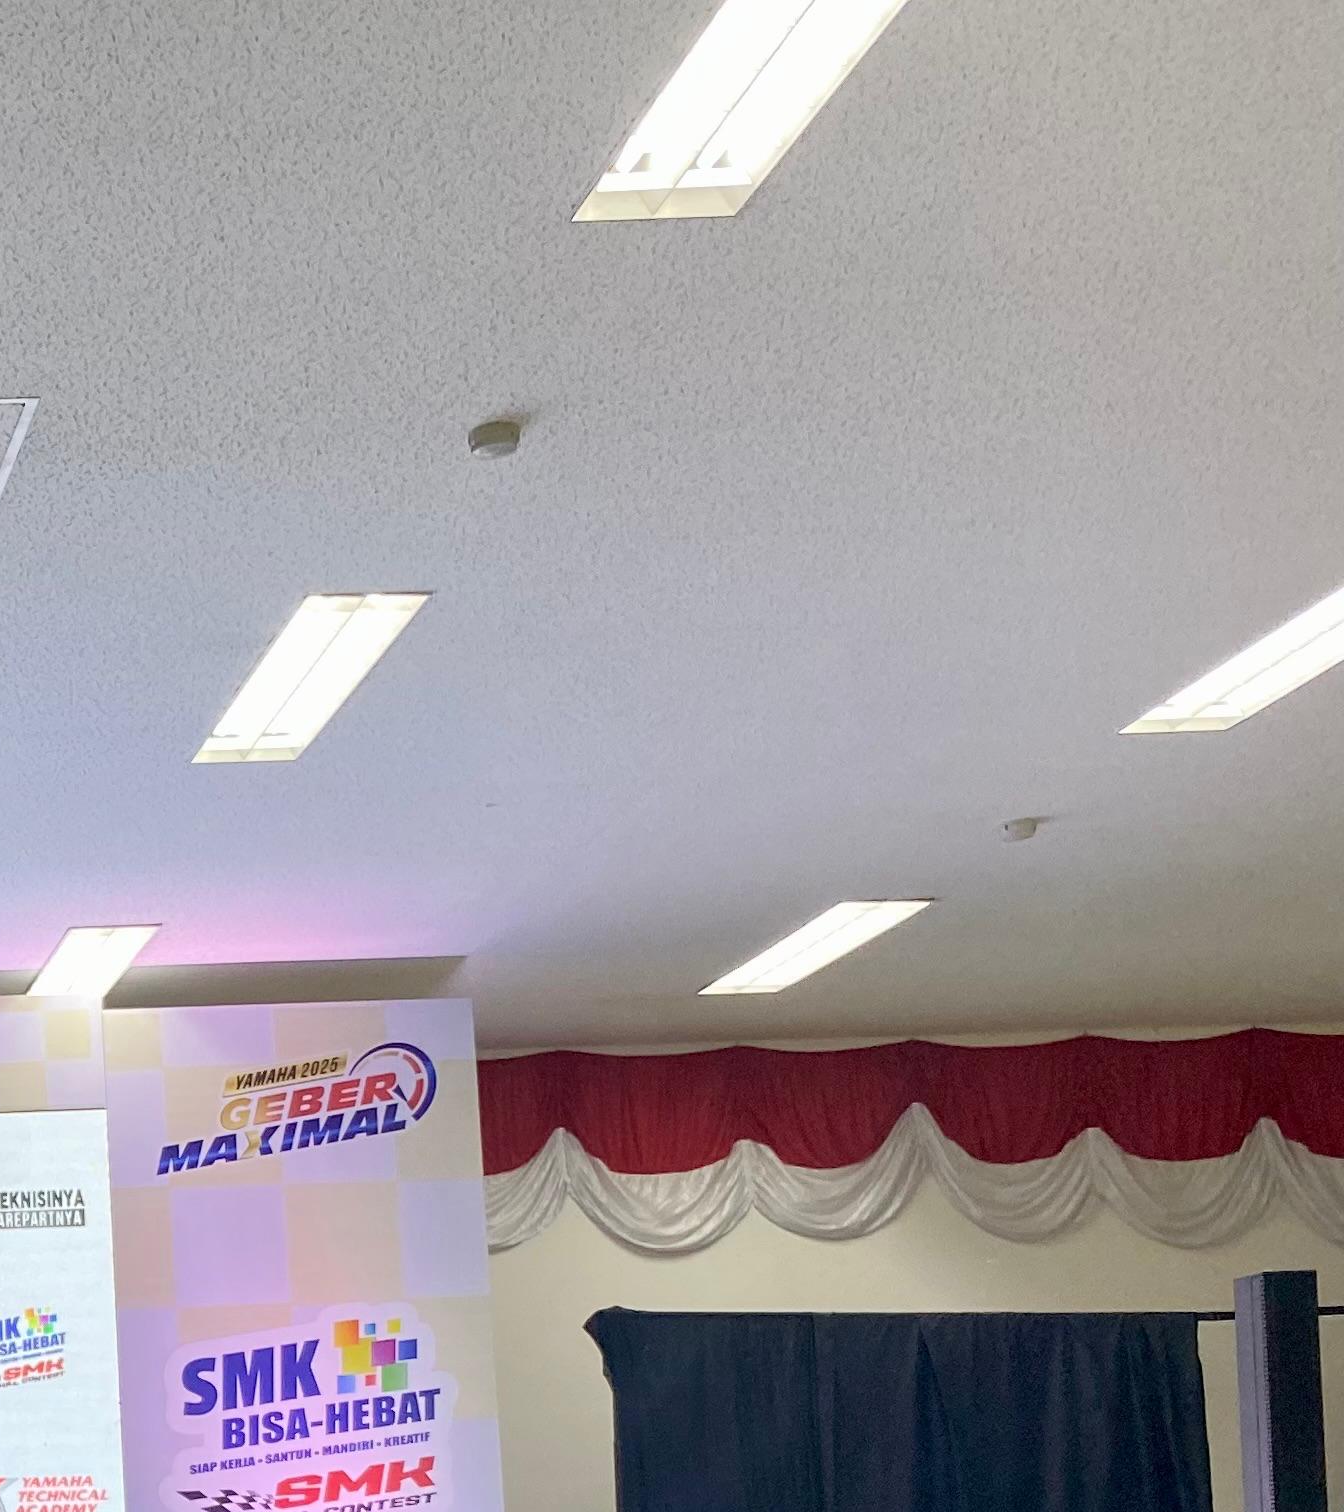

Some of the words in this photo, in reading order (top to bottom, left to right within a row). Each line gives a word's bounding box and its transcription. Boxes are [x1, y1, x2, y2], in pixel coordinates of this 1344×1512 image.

[236, 1064, 297, 1090] YAMAHA
[301, 1057, 339, 1078] 2025
[220, 1072, 398, 1131] GEBER
[157, 1103, 407, 1175] MAXIMAL
[2, 1358, 65, 1382] SMK
[181, 1338, 322, 1416] SMK
[222, 1388, 441, 1450] BISA-HEBAT
[190, 1462, 218, 1475] SIAP
[265, 1449, 312, 1464] SANTUN
[322, 1439, 374, 1456] MANDIRI
[384, 1431, 431, 1448] KREATIF
[18, 1489, 109, 1502] TECHNICAL
[22, 1475, 93, 1488] YAMAHA
[274, 1456, 436, 1510] SMK
